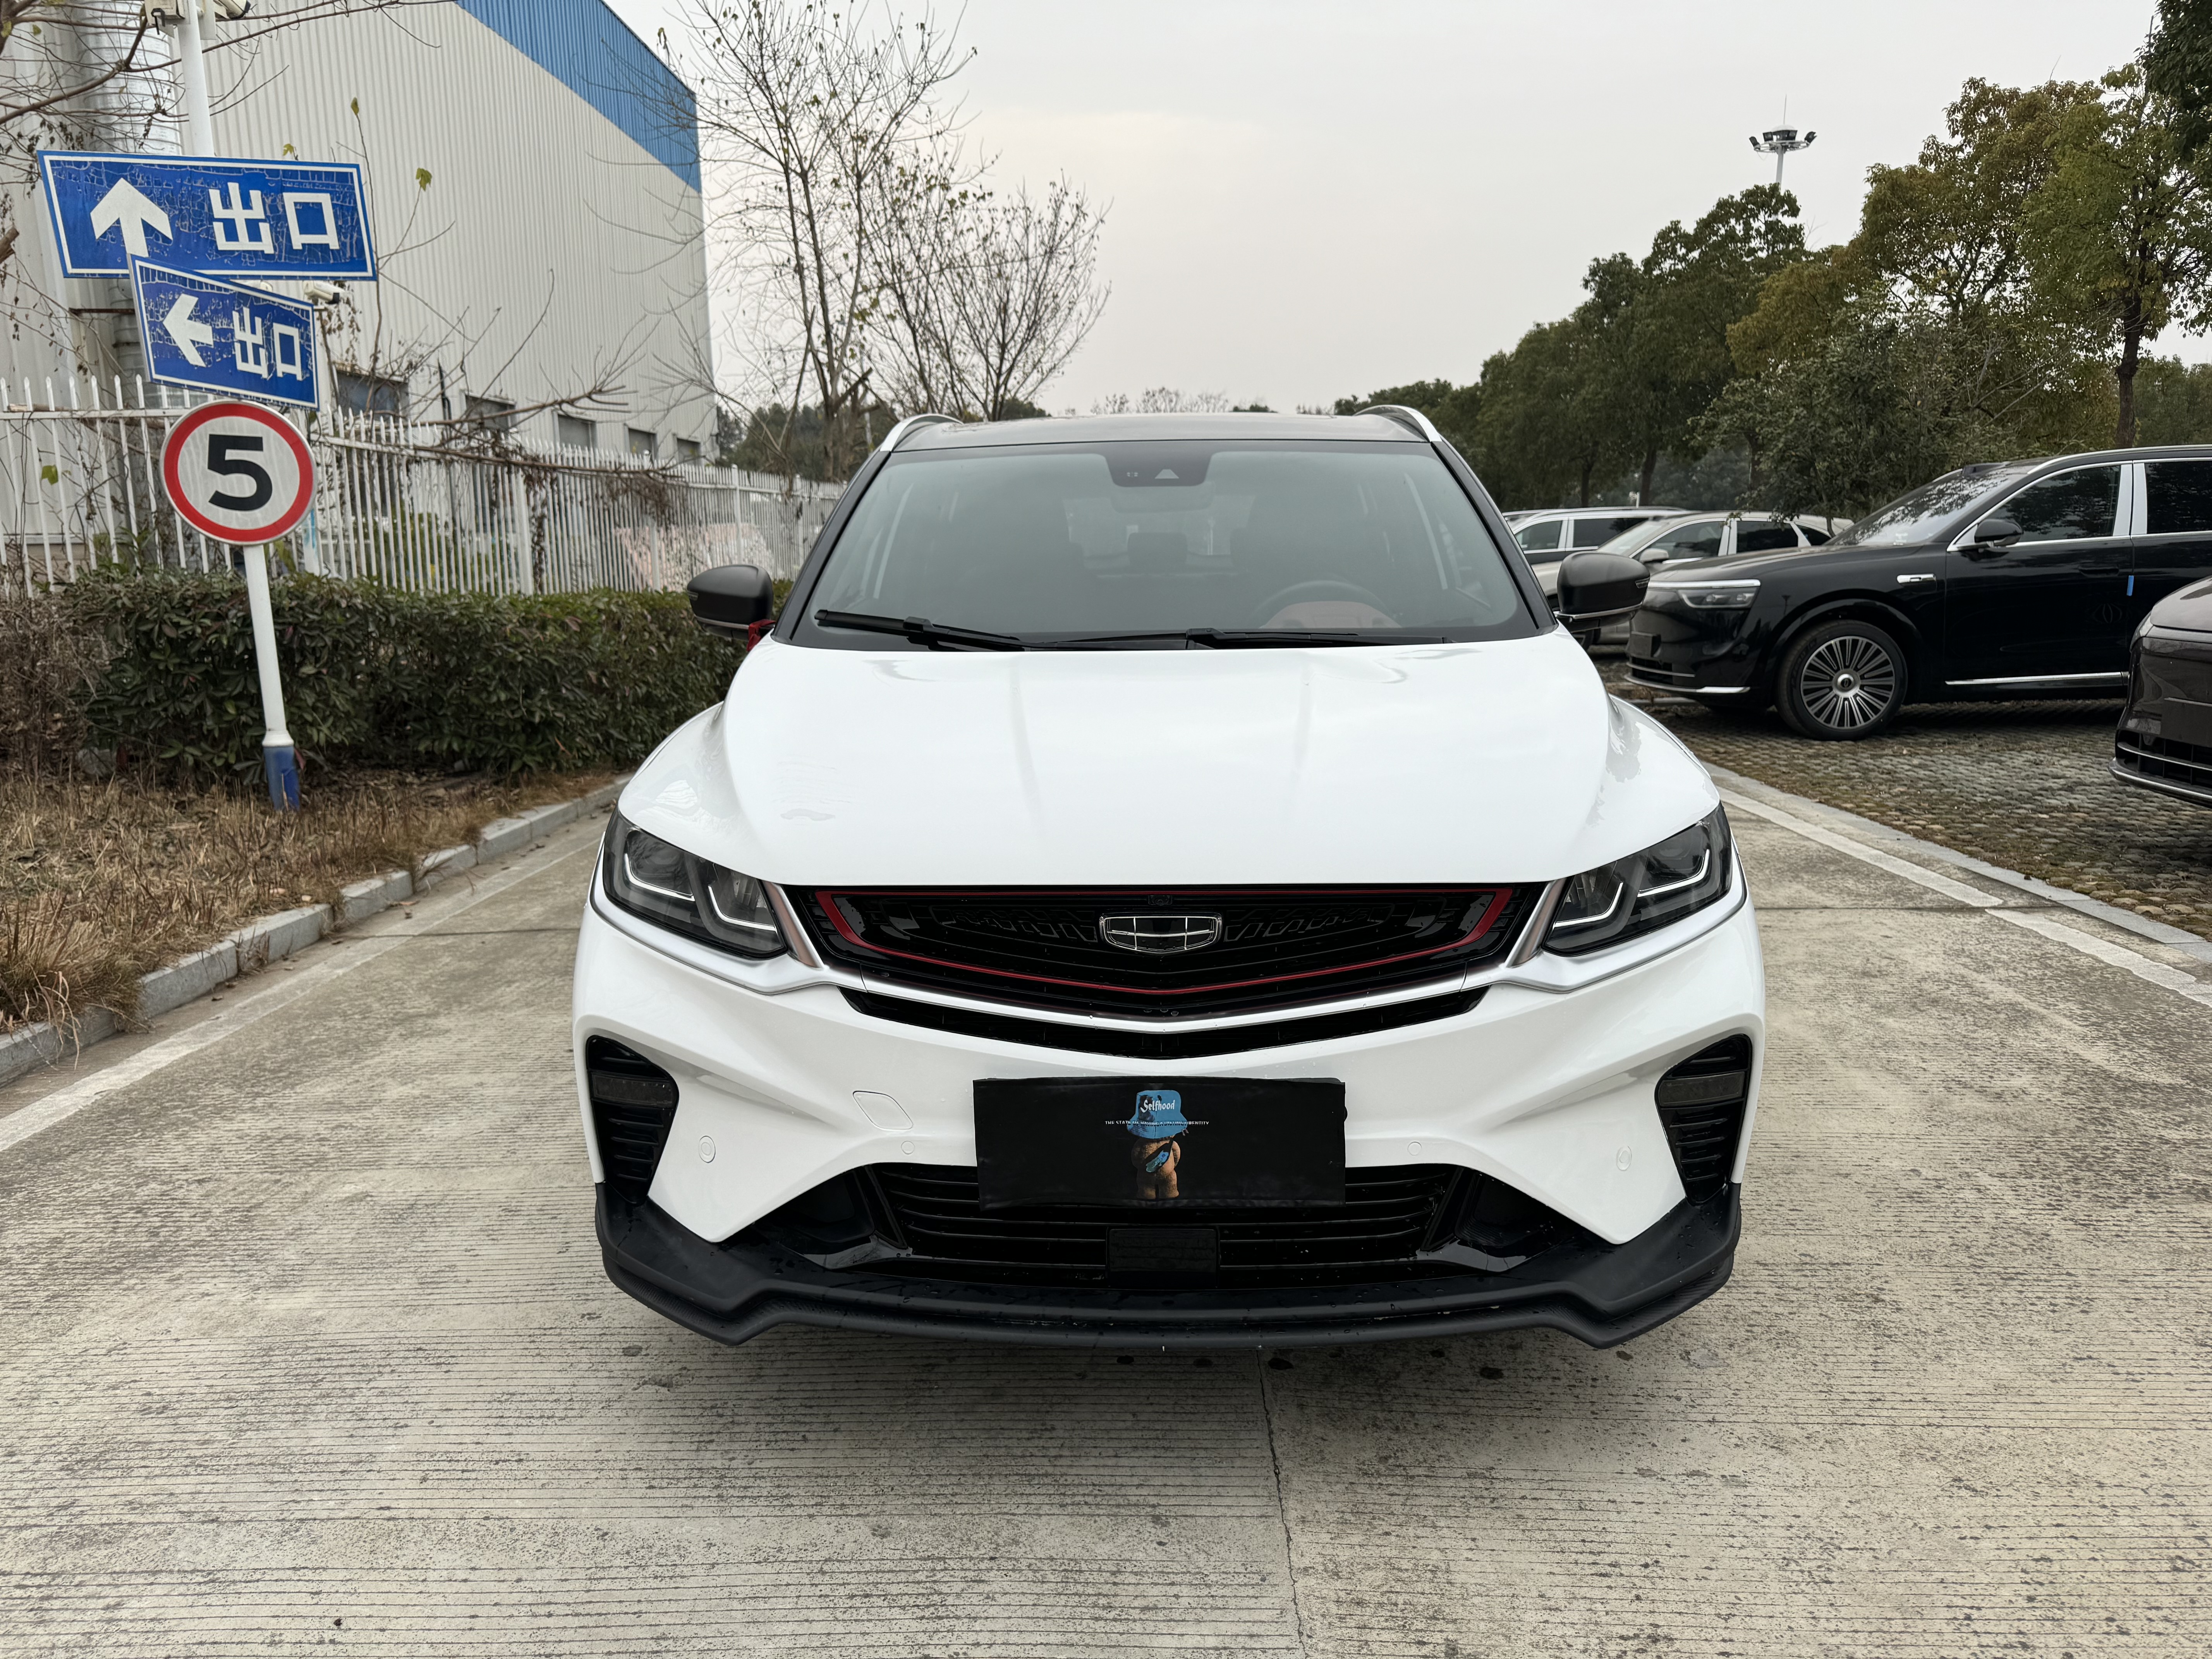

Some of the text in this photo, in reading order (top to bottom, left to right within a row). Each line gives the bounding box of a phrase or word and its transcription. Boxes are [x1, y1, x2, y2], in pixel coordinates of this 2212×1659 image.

[208, 182, 340, 254] 出口
[232, 306, 302, 381] 出口
[207, 434, 273, 511] 5
[1140, 1099, 1175, 1113] Selfhood
